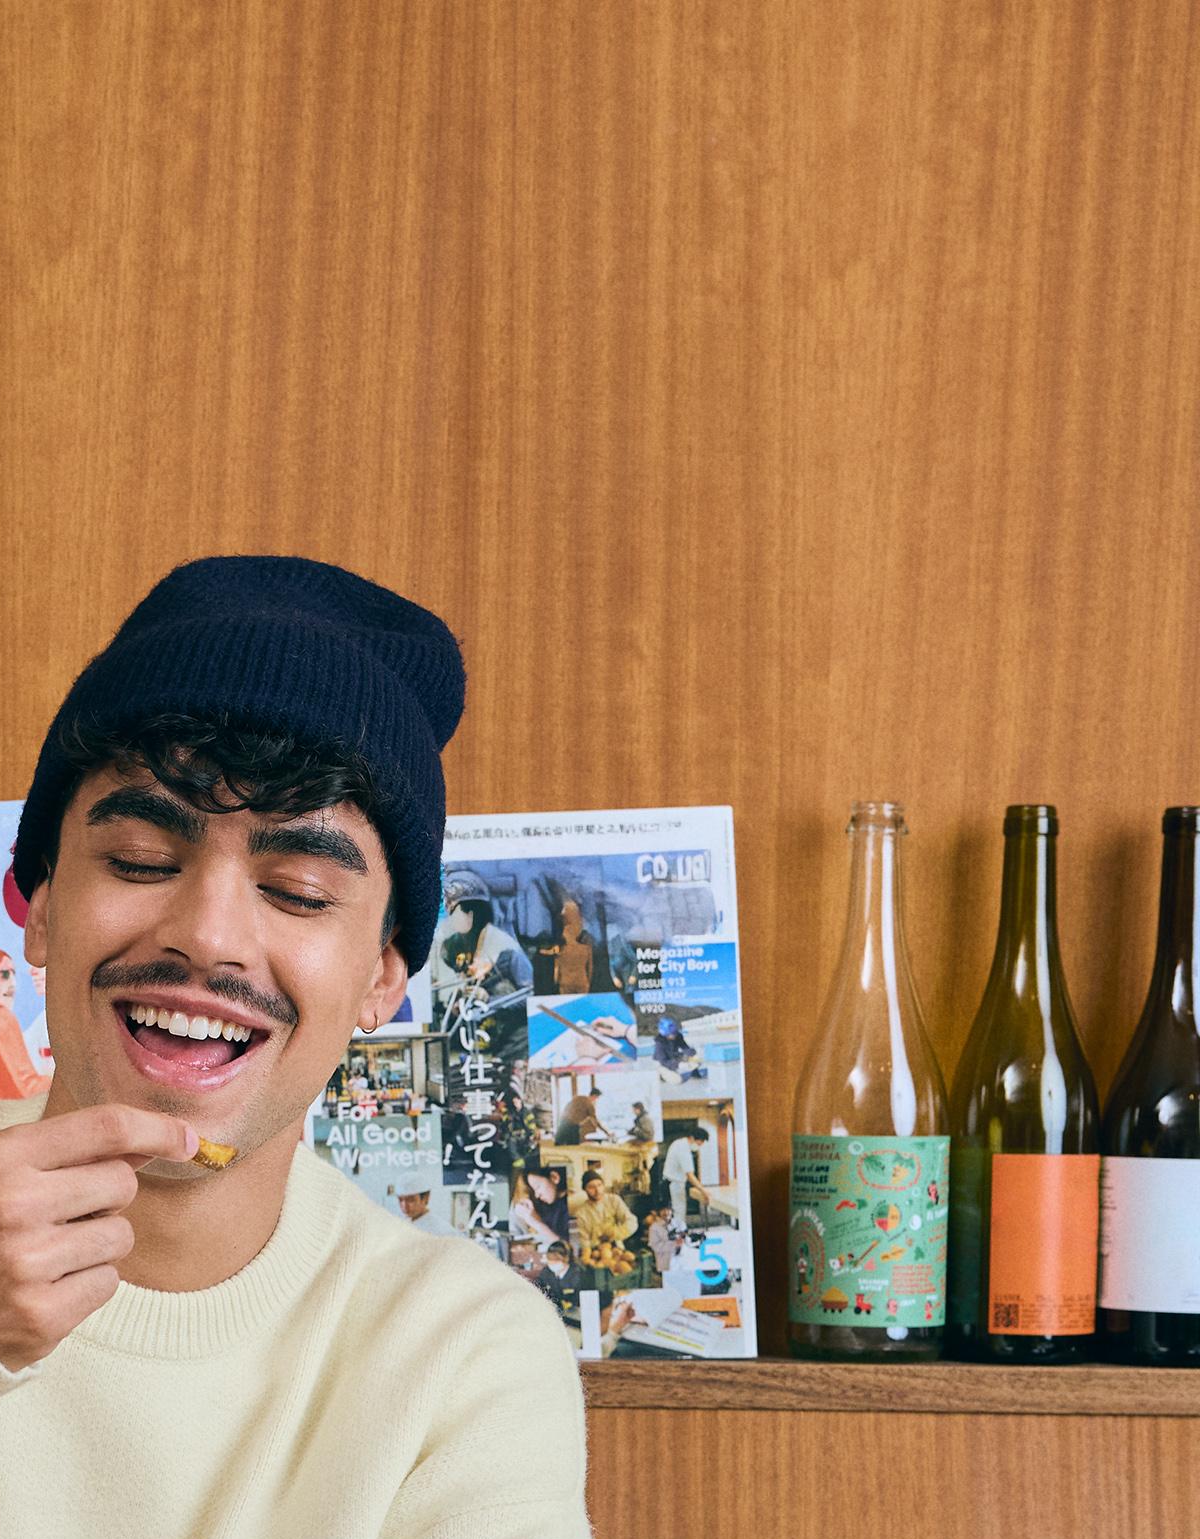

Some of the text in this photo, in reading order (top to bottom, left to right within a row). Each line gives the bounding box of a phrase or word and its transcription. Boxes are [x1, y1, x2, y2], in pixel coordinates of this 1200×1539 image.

[636, 947, 704, 960] Magazine
[637, 959, 718, 974] for City Boys
[638, 978, 665, 989] ISSUE
[337, 1101, 378, 1122] For
[326, 1121, 432, 1146] All Good
[694, 1238, 728, 1287] 5
